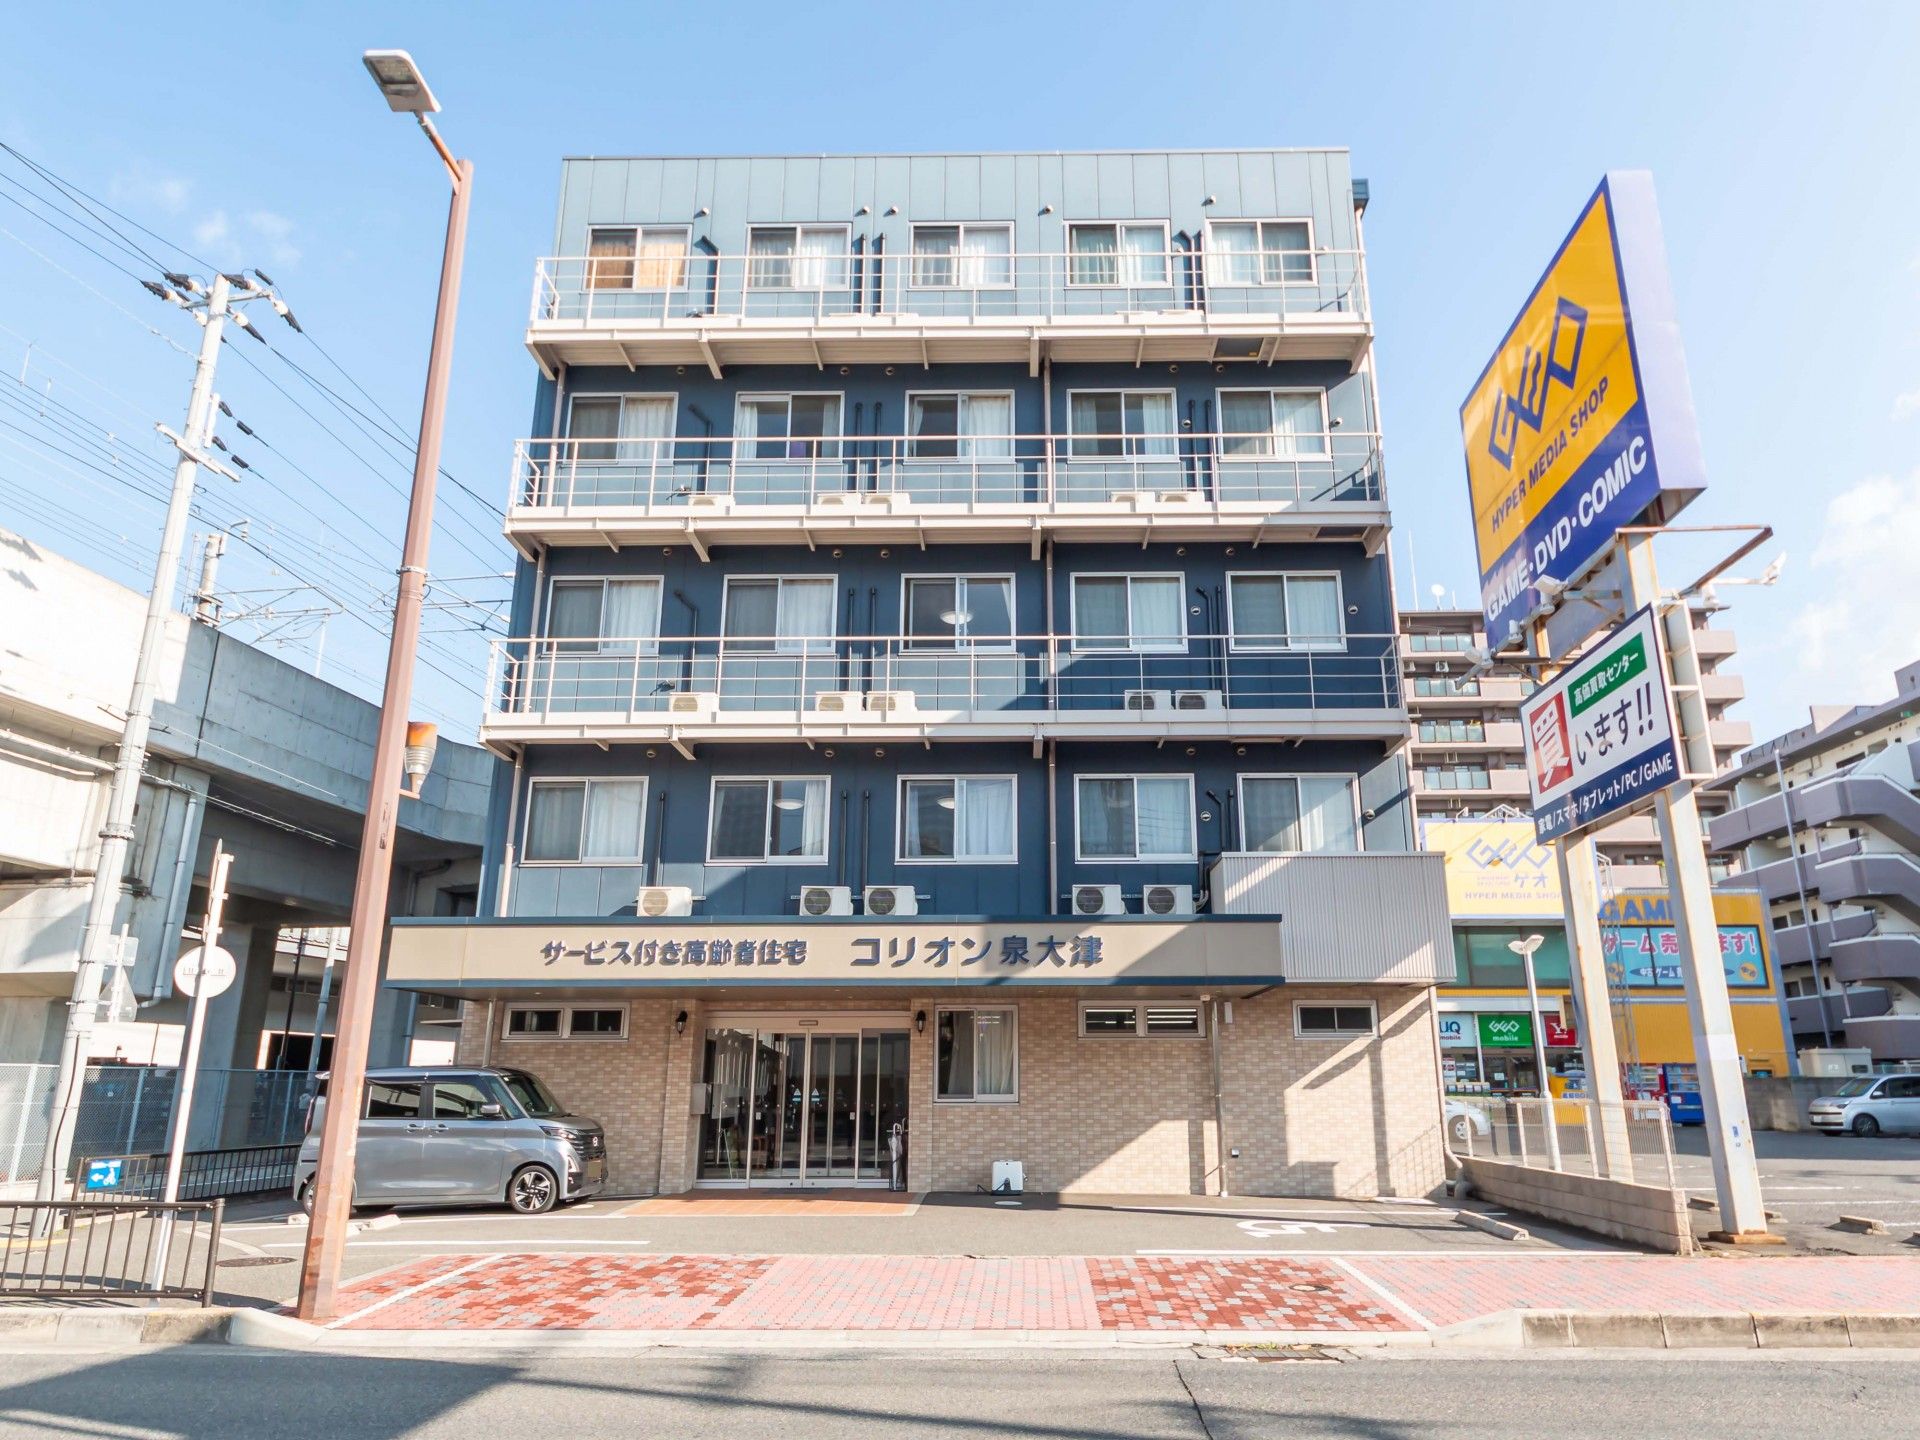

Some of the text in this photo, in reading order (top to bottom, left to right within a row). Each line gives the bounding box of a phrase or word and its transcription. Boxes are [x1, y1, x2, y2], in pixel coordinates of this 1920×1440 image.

[1492, 376, 1609, 533] HYPER MEDIA SHOP
[1573, 652, 1639, 707] 高価買取センター
[1464, 891, 1498, 900] HYPER
[1501, 891, 1532, 900] MEDIA
[540, 935, 1104, 968] サービス付き高齢者住宅 コリオン泉大津
[1439, 1021, 1461, 1034] UQ
